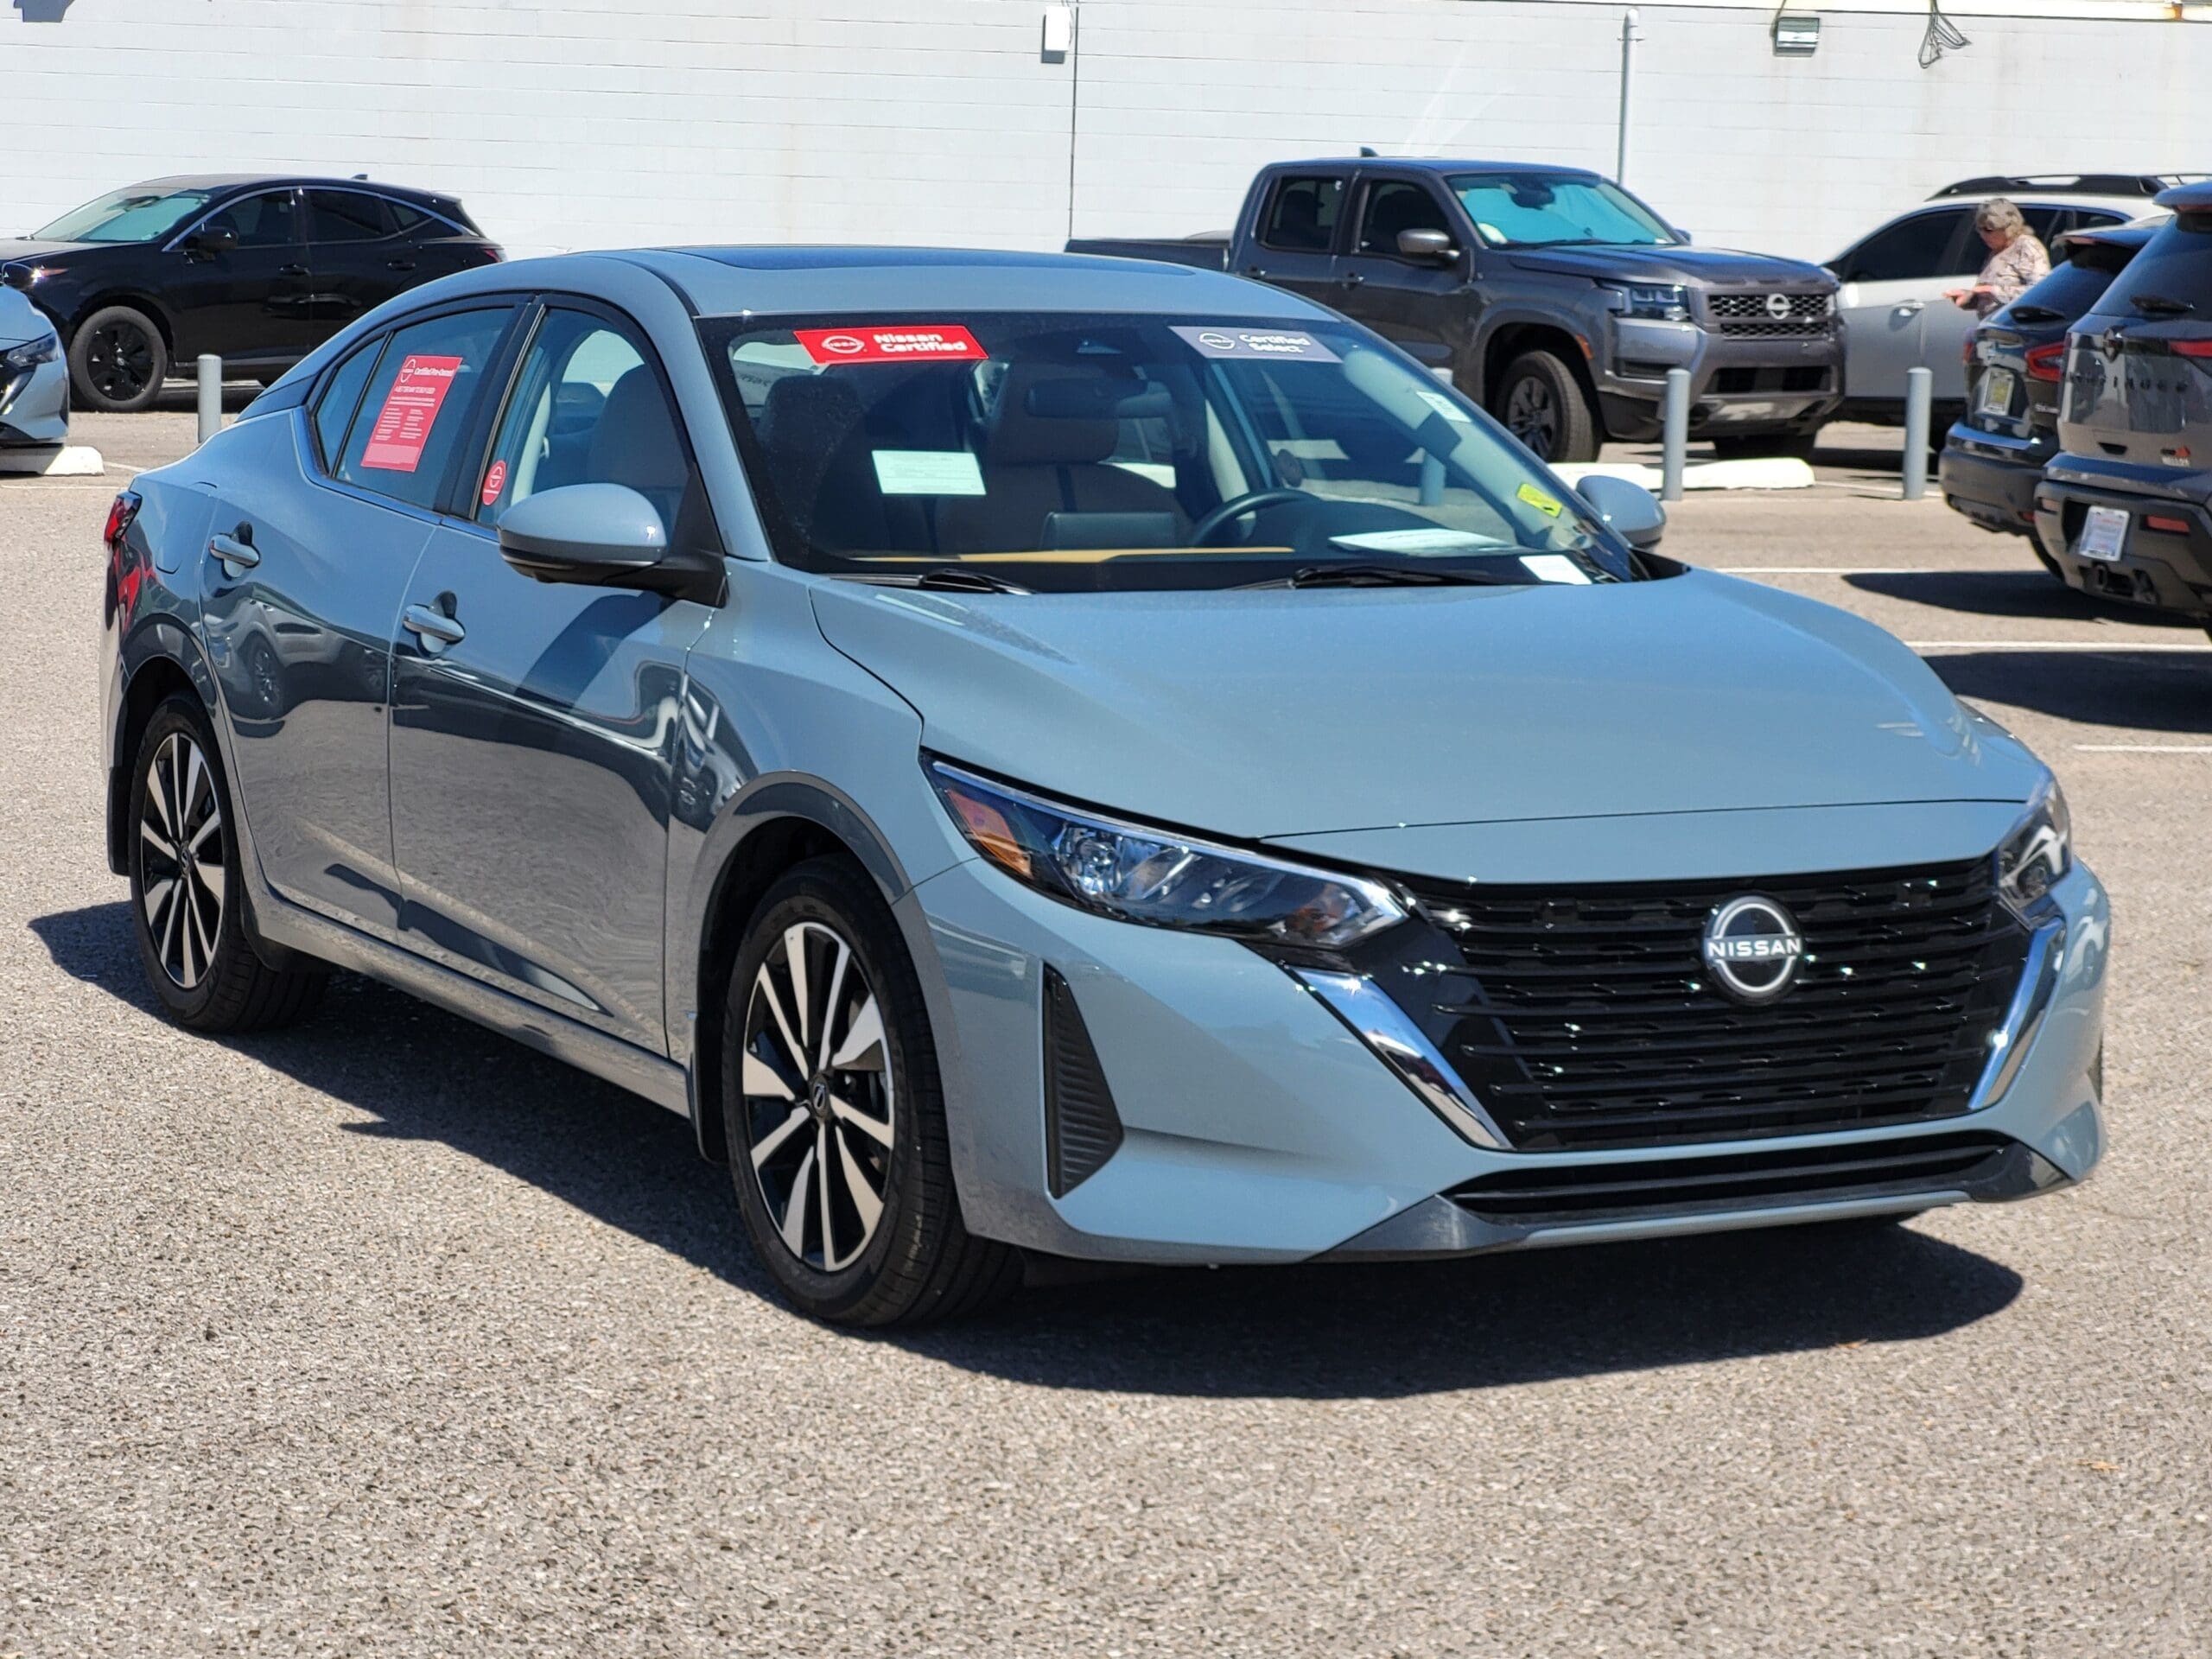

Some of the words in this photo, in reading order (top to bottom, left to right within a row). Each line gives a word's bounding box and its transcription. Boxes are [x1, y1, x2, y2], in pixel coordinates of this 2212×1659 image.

[873, 334, 944, 344] Nissan
[880, 341, 968, 353] Certified
[1707, 938, 1801, 957] NISSAN
